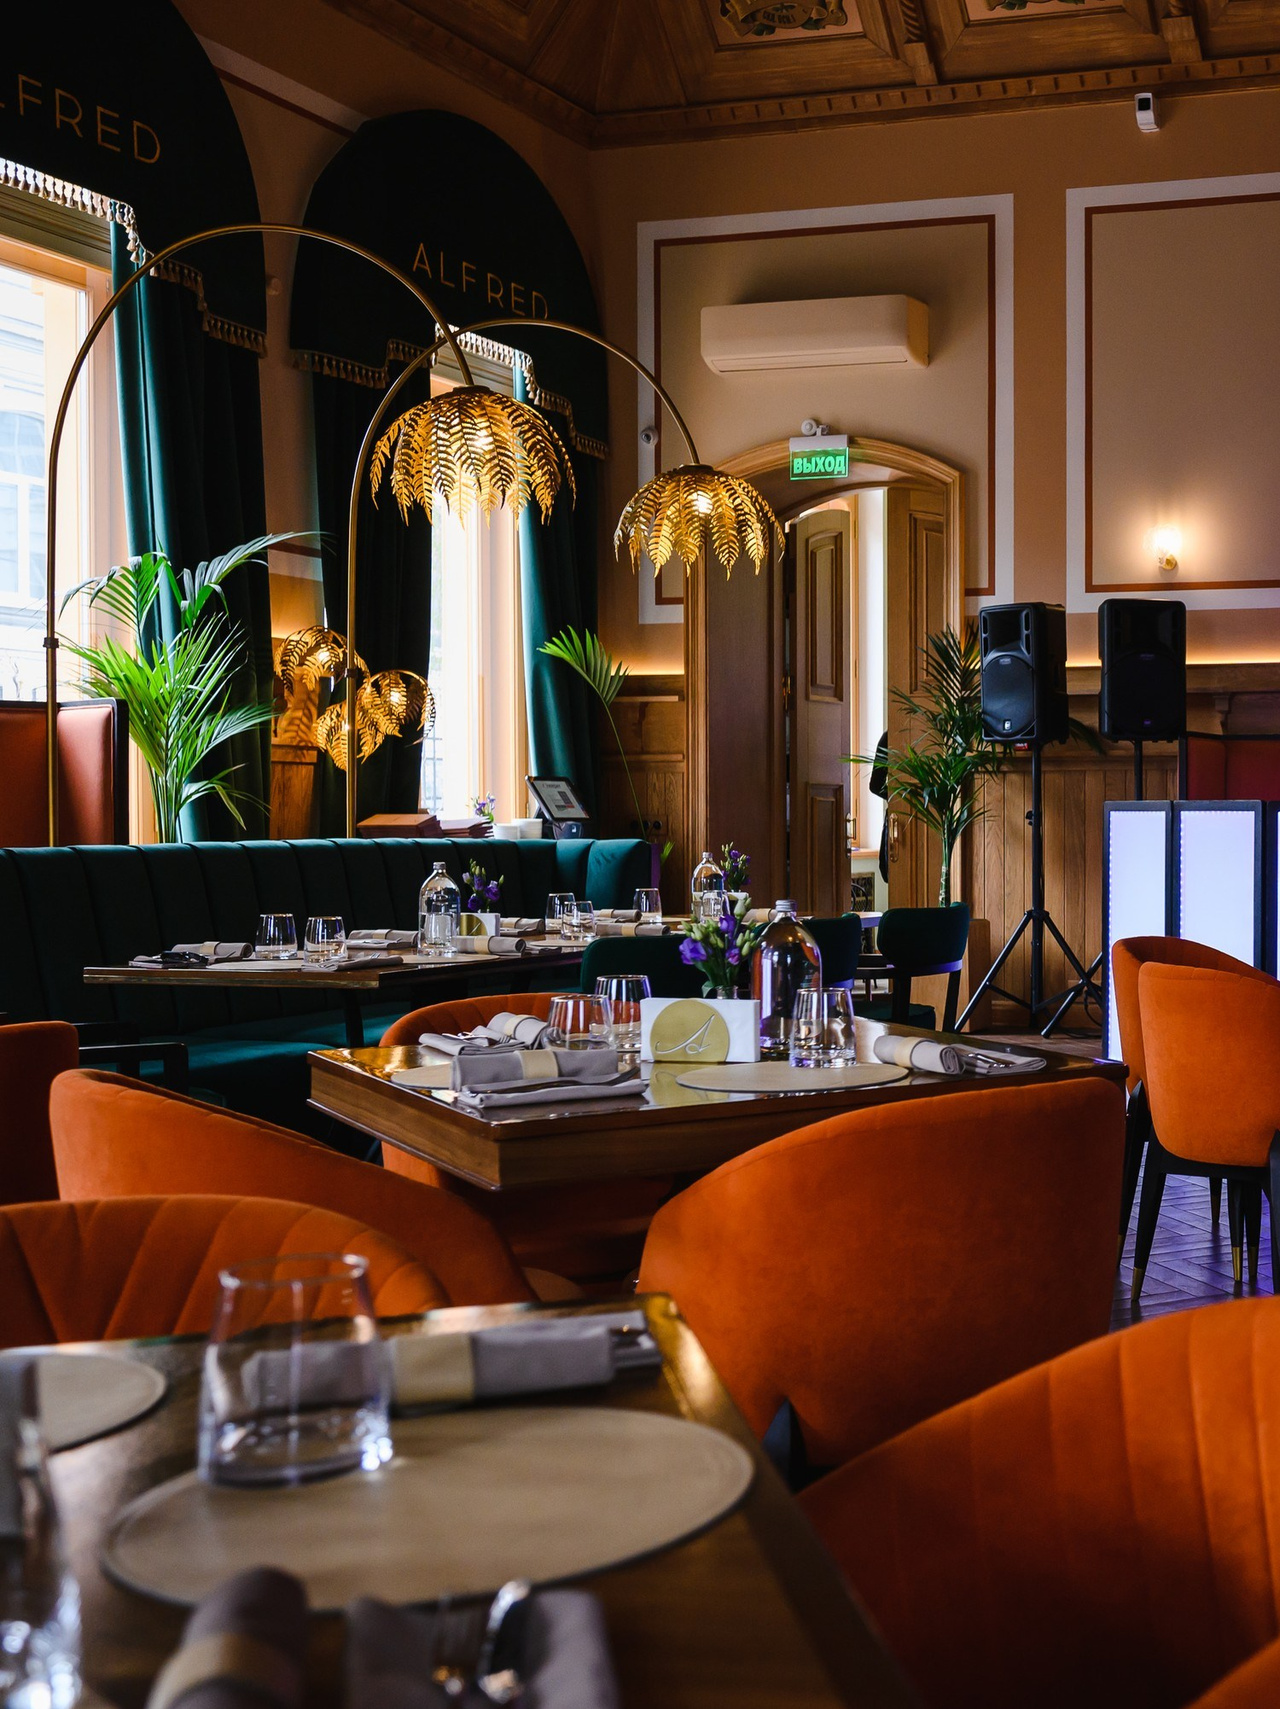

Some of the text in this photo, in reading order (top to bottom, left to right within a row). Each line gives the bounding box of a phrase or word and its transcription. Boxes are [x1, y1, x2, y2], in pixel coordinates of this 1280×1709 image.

[0, 74, 161, 164] FRED
[412, 242, 549, 320] ALFRED
[793, 455, 846, 475] ВЫХОД
